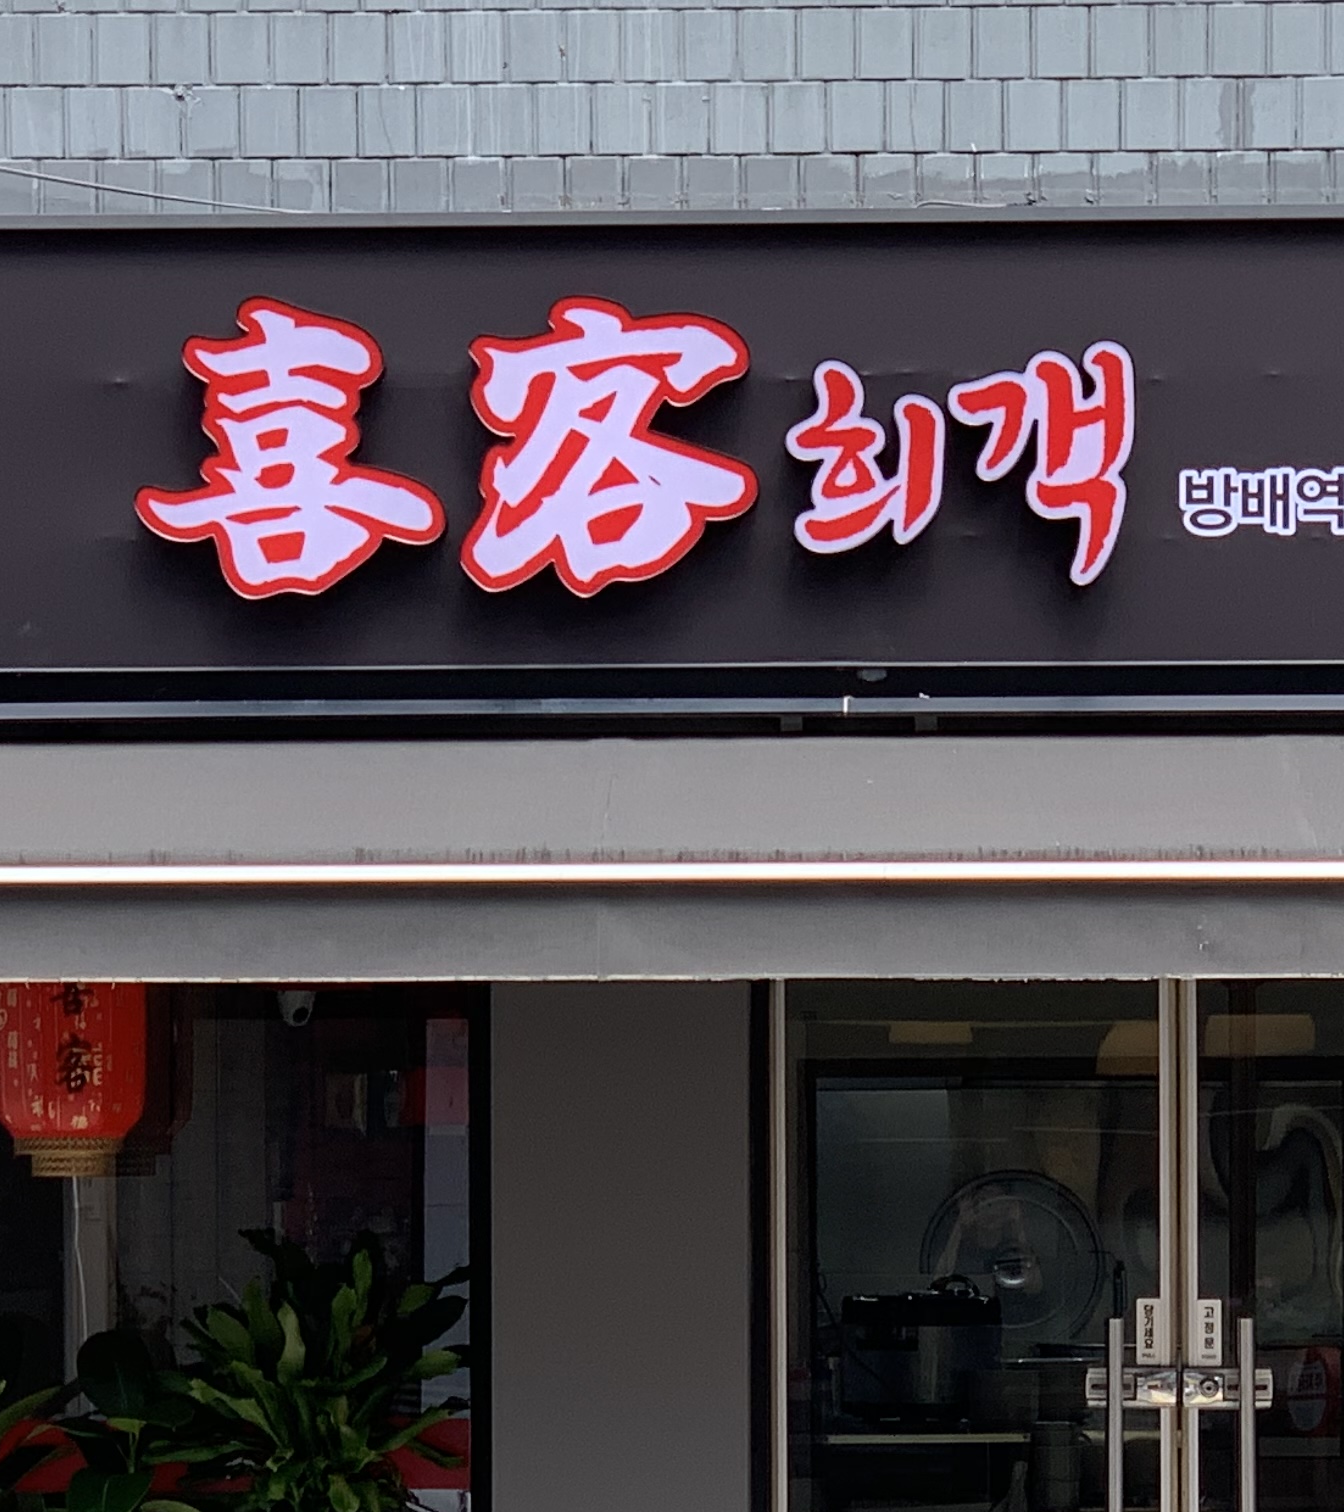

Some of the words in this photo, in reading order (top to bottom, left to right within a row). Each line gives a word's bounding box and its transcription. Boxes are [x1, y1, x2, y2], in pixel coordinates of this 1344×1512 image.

[136, 300, 758, 599] 喜客
[787, 342, 1138, 587] 희객
[1143, 1304, 1154, 1349] 당기세요
[1203, 1306, 1215, 1350] 고정문
